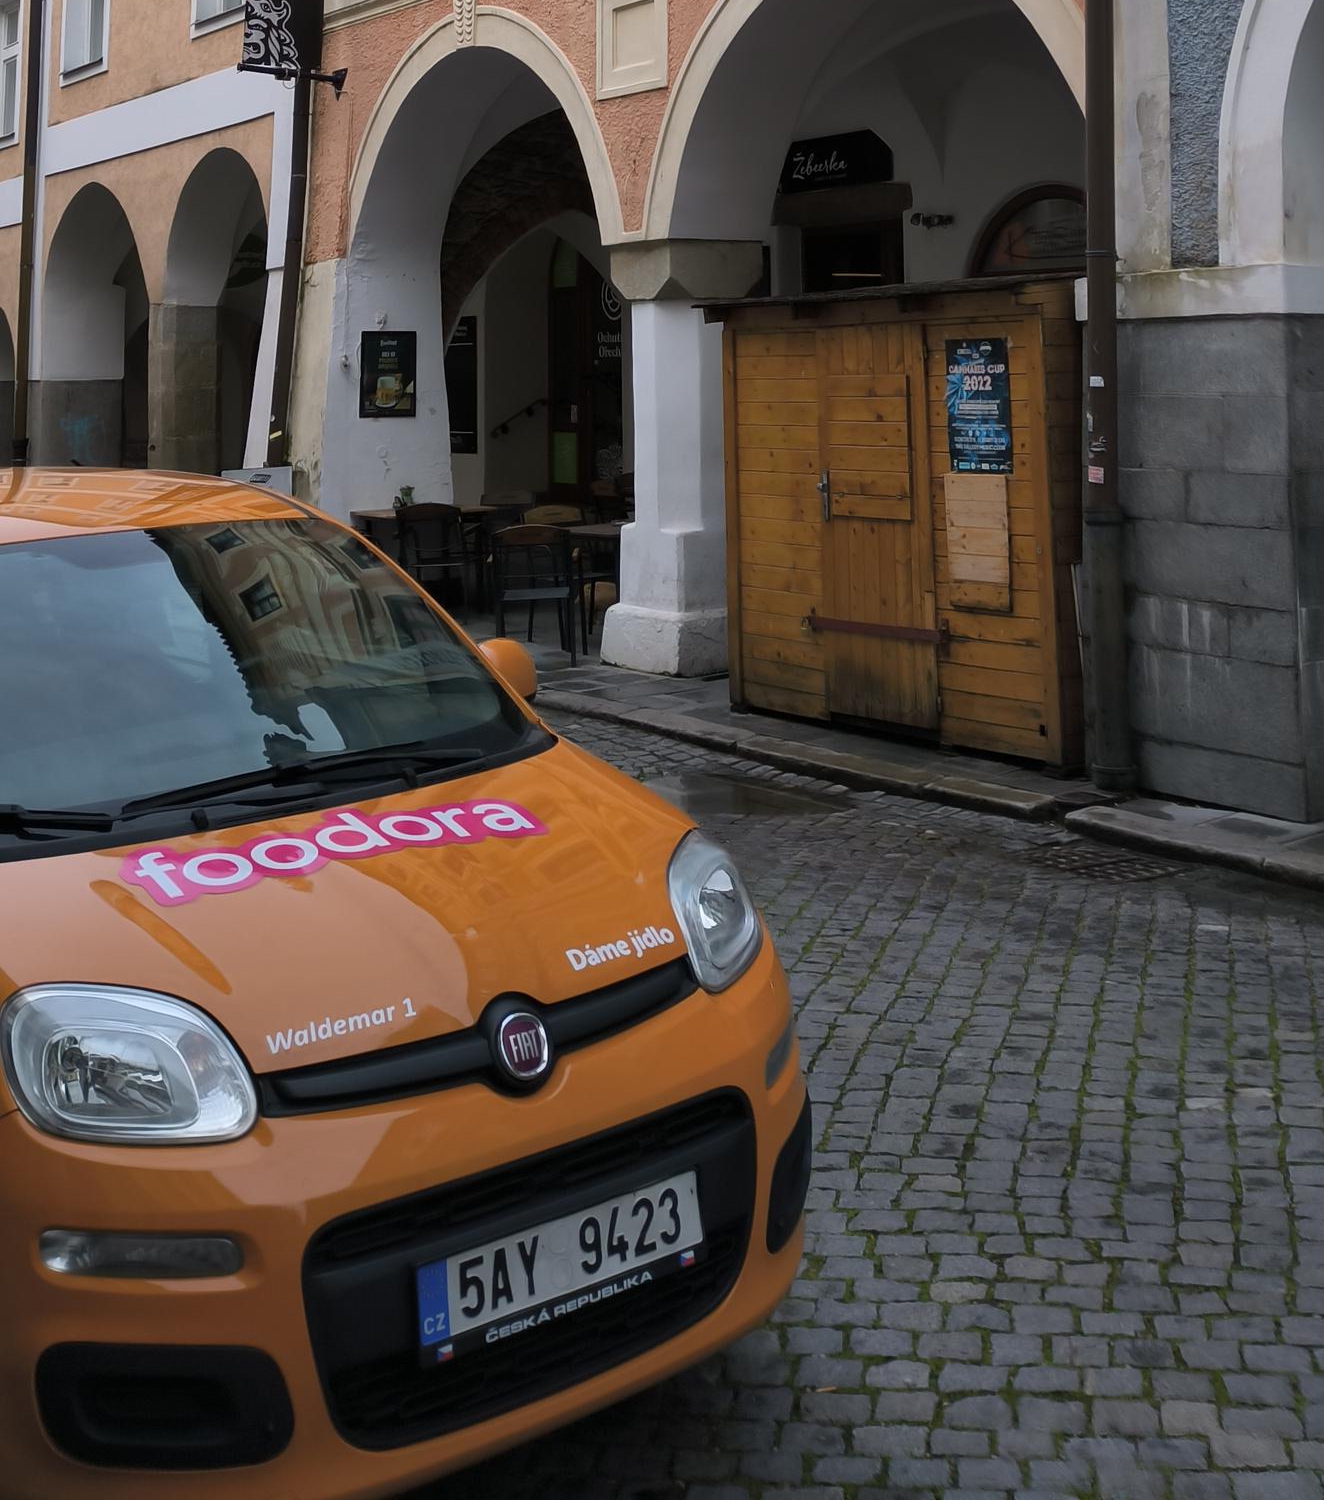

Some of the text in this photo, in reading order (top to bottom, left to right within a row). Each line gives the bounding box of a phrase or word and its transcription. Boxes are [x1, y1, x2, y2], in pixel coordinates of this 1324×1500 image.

[792, 151, 848, 180] Žebeerka
[962, 375, 993, 391] 2022
[987, 363, 1006, 374] CUP
[135, 800, 535, 899] foodora
[565, 925, 675, 973] Dáme jídlo
[265, 997, 418, 1056] Waldemar 1
[508, 1027, 541, 1061] FIAT
[458, 1187, 682, 1319] 5AY 9423
[423, 1312, 446, 1336] CZ
[485, 1270, 653, 1344] ČESKÁ REPUBLIKA
